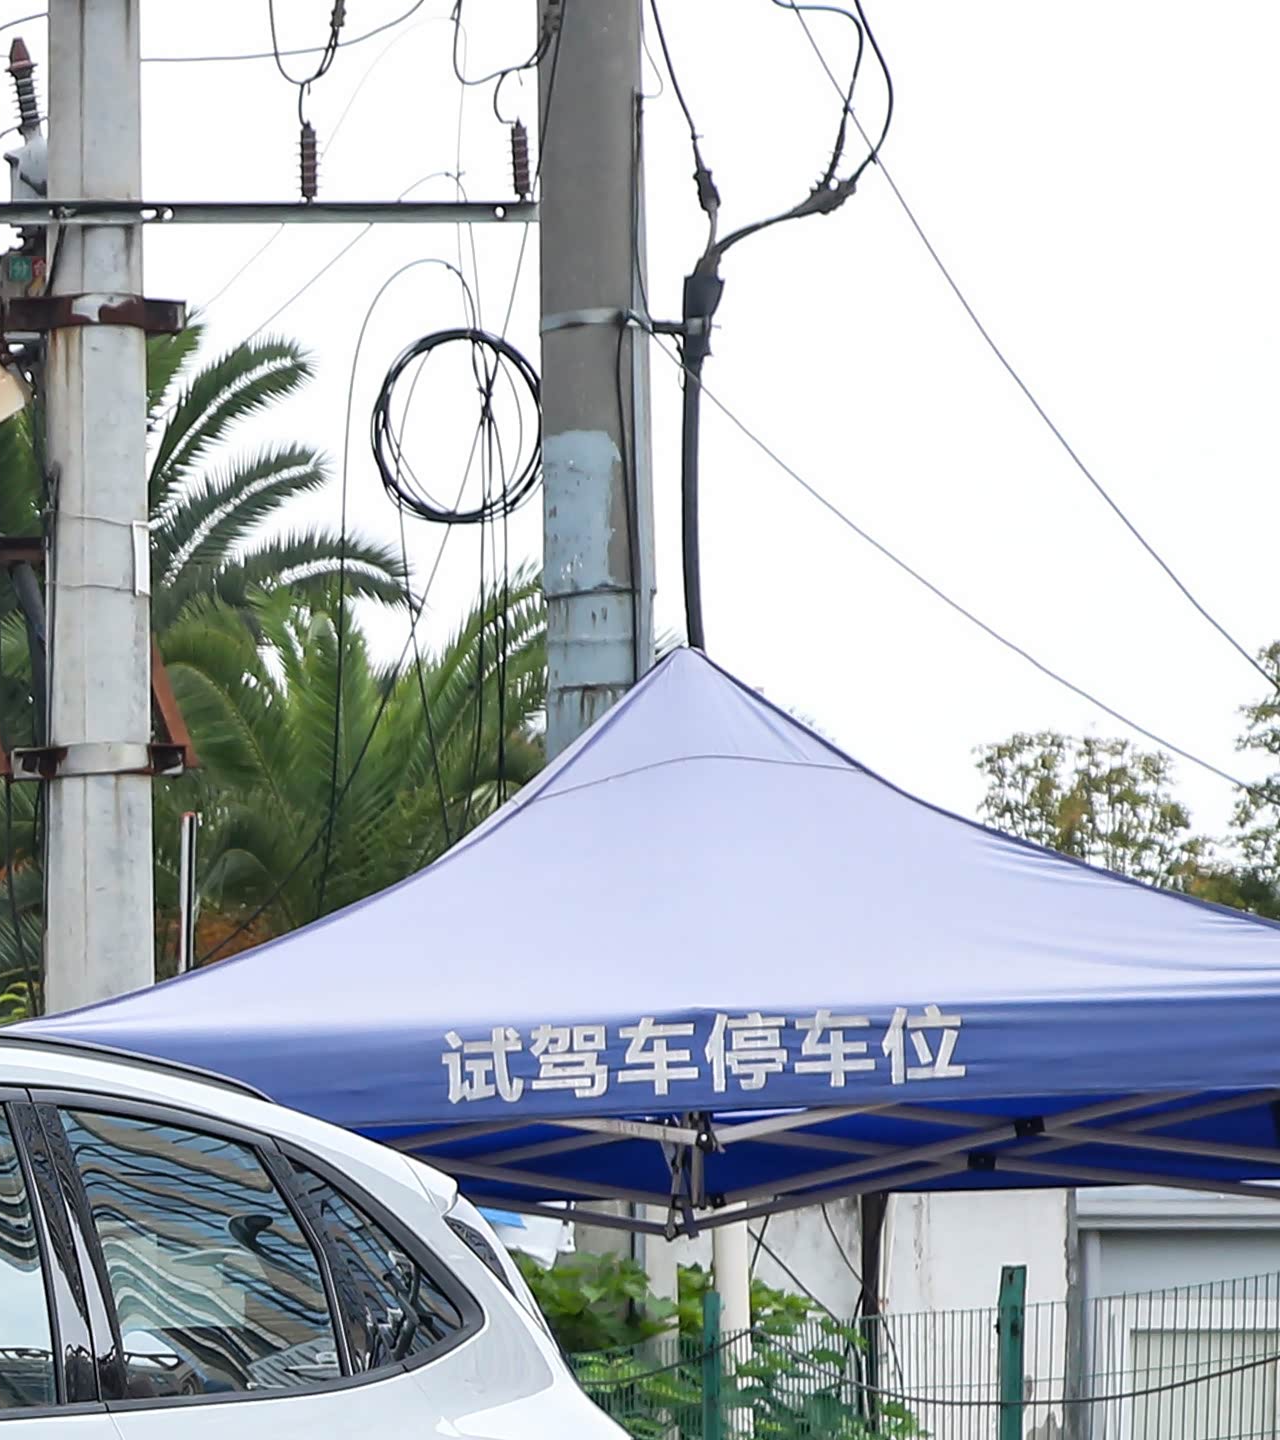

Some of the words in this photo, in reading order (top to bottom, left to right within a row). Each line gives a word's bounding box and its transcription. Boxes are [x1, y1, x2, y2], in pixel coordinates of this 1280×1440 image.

[441, 1003, 966, 1104] 试驾车停车位
